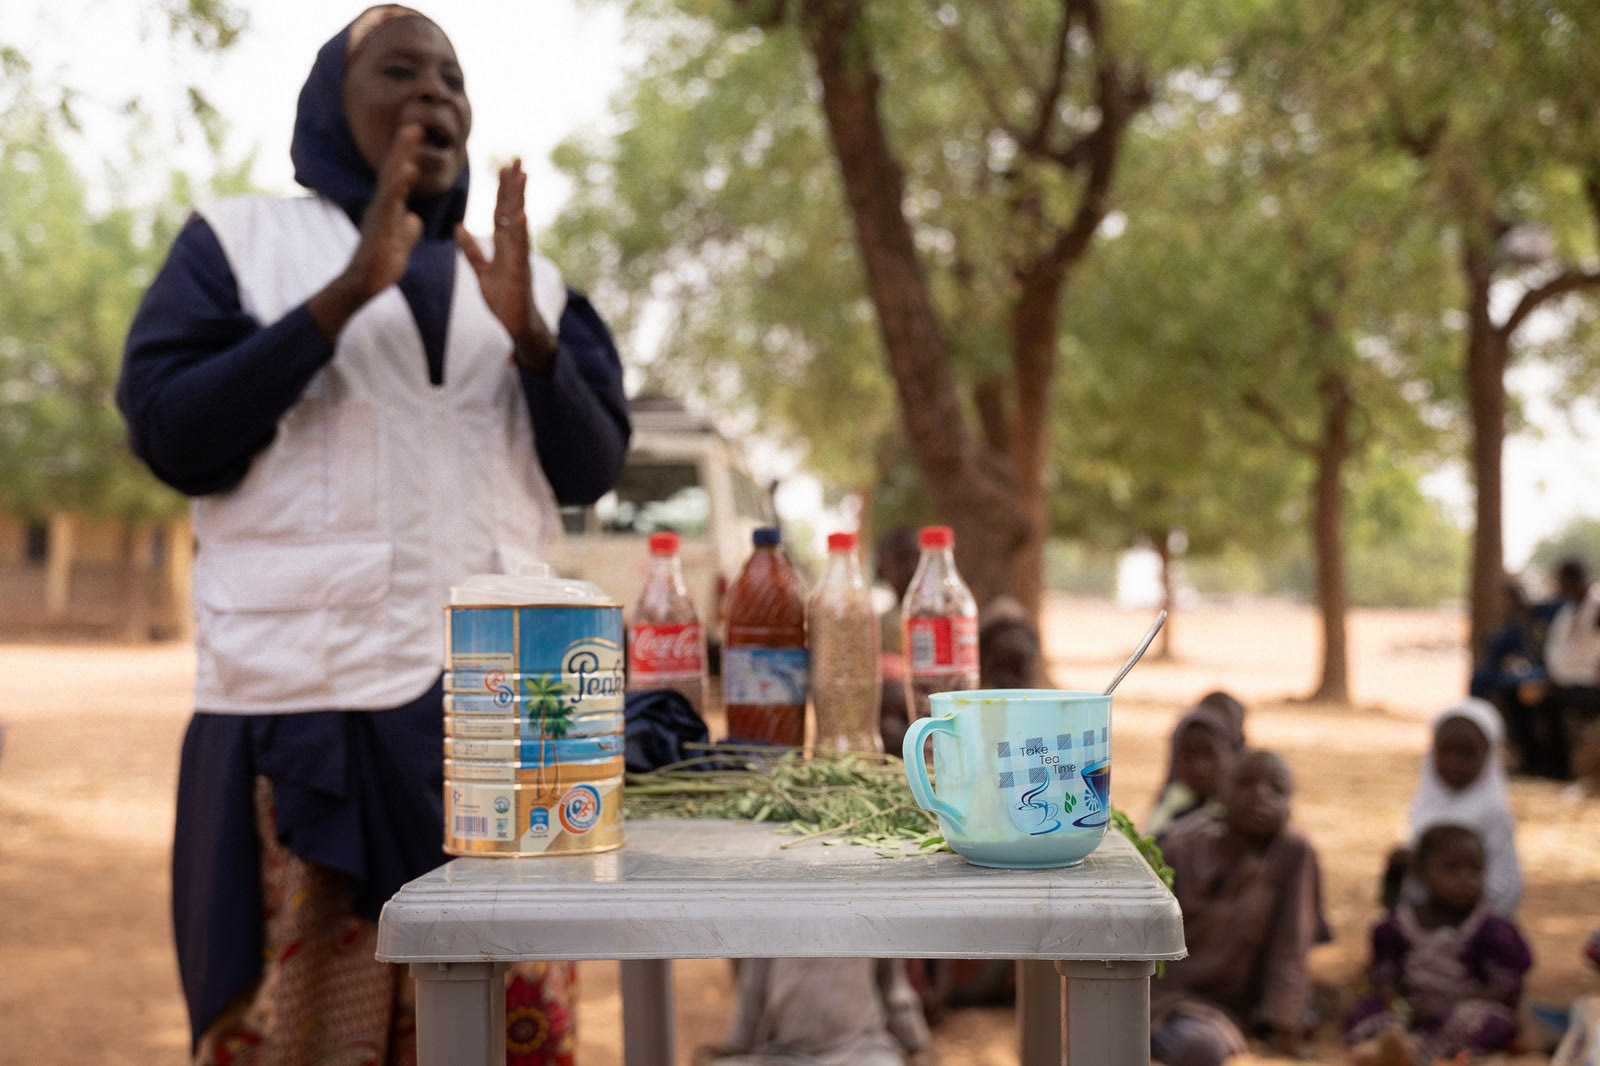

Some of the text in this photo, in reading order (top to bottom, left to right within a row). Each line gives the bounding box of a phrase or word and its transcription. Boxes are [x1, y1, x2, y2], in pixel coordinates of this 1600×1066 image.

[568, 651, 622, 703] Peak
[1020, 745, 1049, 757] Take
[1040, 755, 1060, 765] Tea
[1053, 763, 1077, 774] Time
